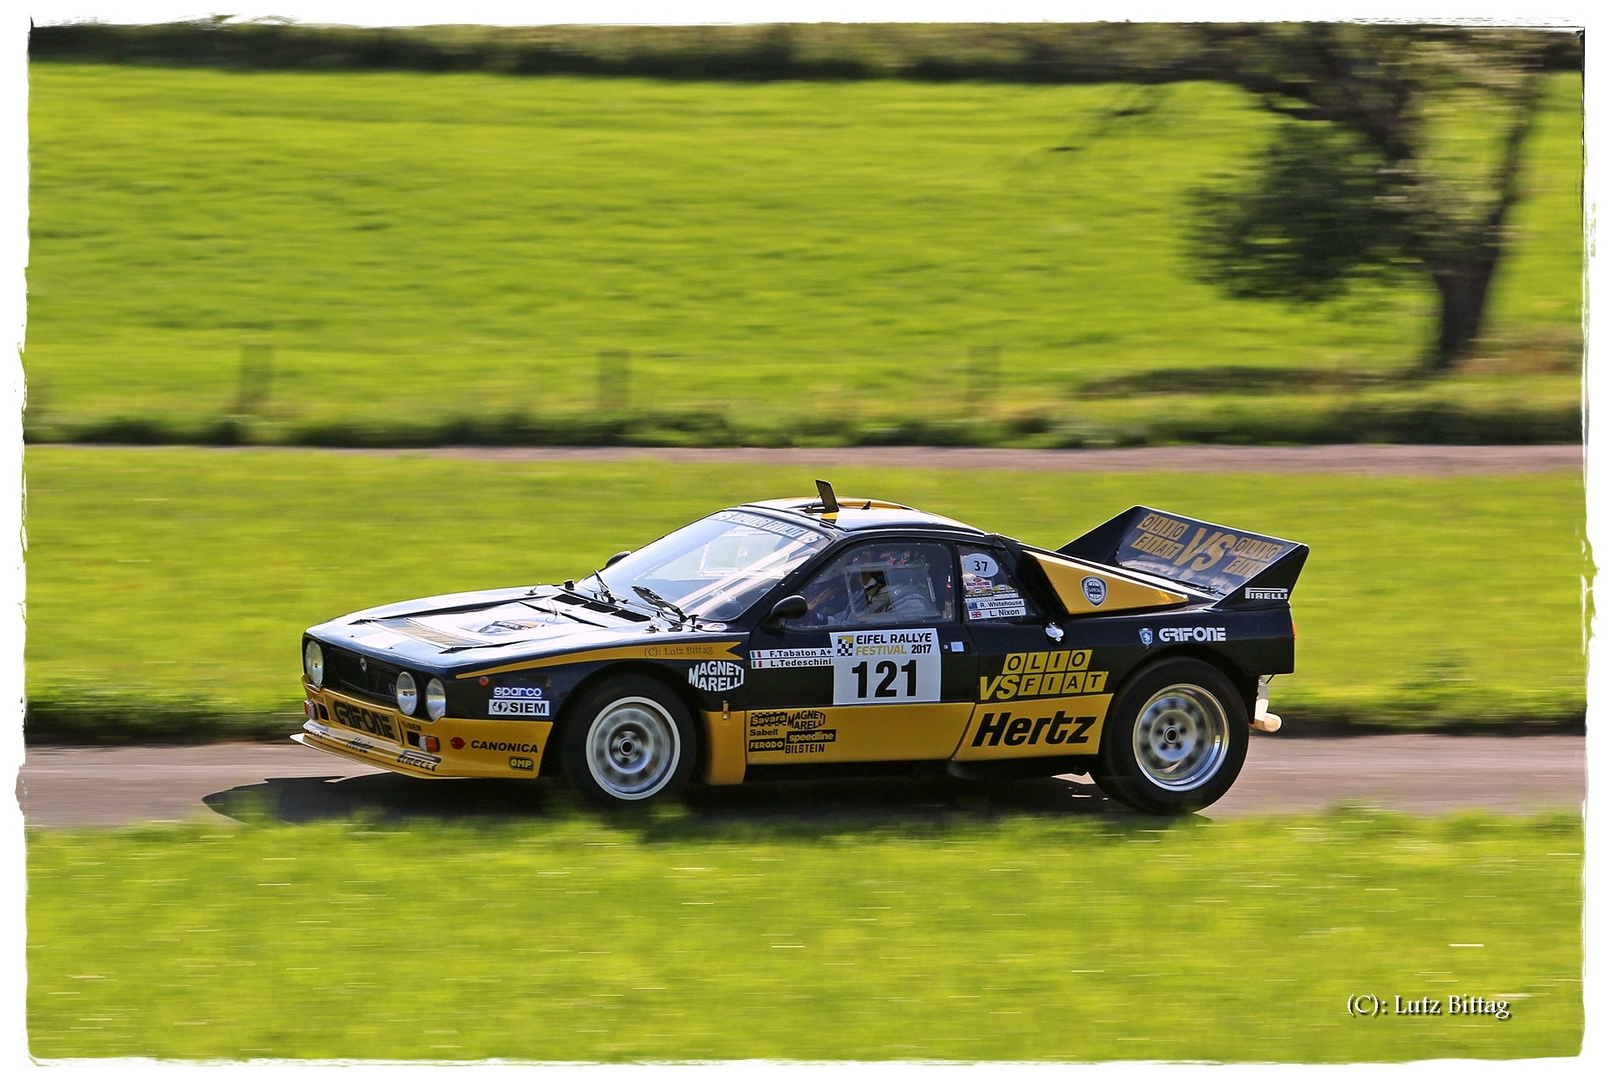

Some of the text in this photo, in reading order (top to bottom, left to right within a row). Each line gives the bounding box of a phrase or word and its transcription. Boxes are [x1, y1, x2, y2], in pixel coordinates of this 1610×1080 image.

[1140, 515, 1280, 571] OLIO VS OLIO
[1134, 534, 1261, 578] FIAT FIA
[973, 560, 988, 572] 37
[1245, 587, 1288, 600] PIRELLI
[998, 608, 1020, 616] Nixon
[856, 633, 932, 645] EIFEL RALLYE
[1158, 627, 1227, 642] GRIFONE
[855, 644, 932, 656] FESTIVAL 2017
[1005, 651, 1088, 672] OLIO
[688, 661, 744, 681] MAGNETI
[688, 675, 744, 692] MARELLI
[851, 659, 917, 699] 121
[493, 686, 542, 698] sparco
[980, 673, 1104, 700] VS FIAT
[509, 702, 546, 713] SIEM
[333, 700, 396, 741] GRIFONE
[752, 714, 786, 725] Savara
[787, 710, 826, 723] MAGNETI
[787, 719, 826, 730] MARELLI
[971, 710, 1097, 747] Hertz
[789, 731, 834, 743] speedline
[471, 740, 539, 753] CANONICA
[750, 740, 783, 749] FERODO
[785, 743, 825, 754] BILSTEIN
